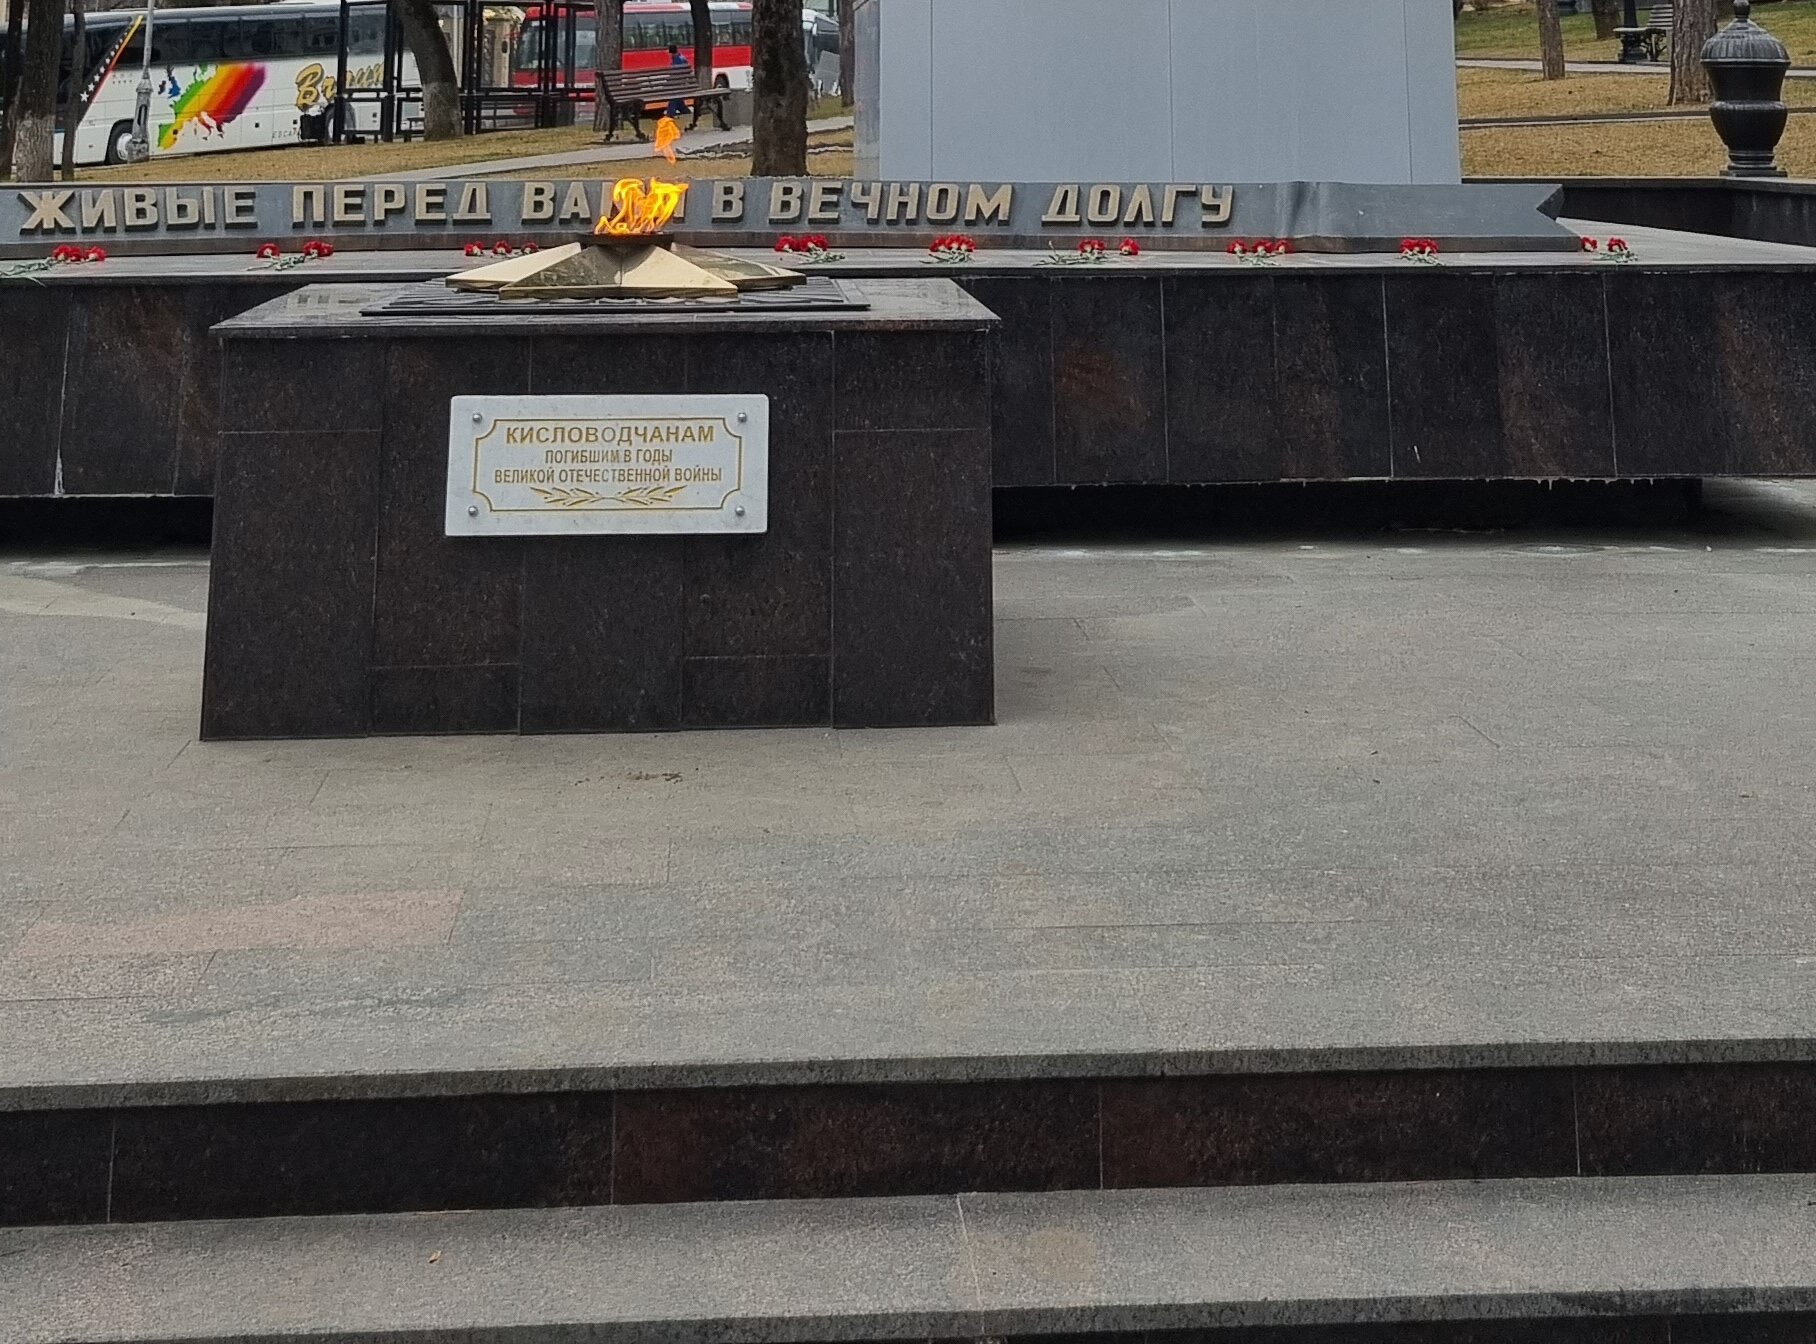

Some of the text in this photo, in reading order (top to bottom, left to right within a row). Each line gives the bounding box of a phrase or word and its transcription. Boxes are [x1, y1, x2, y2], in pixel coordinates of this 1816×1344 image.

[18, 181, 1235, 234] ЖИВЫЕ ПЕРЕД ВА В ВЕЧНОМ ДОЛГУ
[506, 425, 714, 446] КИСЛОВОДЧАНАМ
[545, 448, 673, 465] ПОГИБШИМ В ГОДЫ
[494, 464, 722, 483] ВЕЛИКОЙ ОТЕЧЕСТВЕННОЙ ВОЙНЫ
